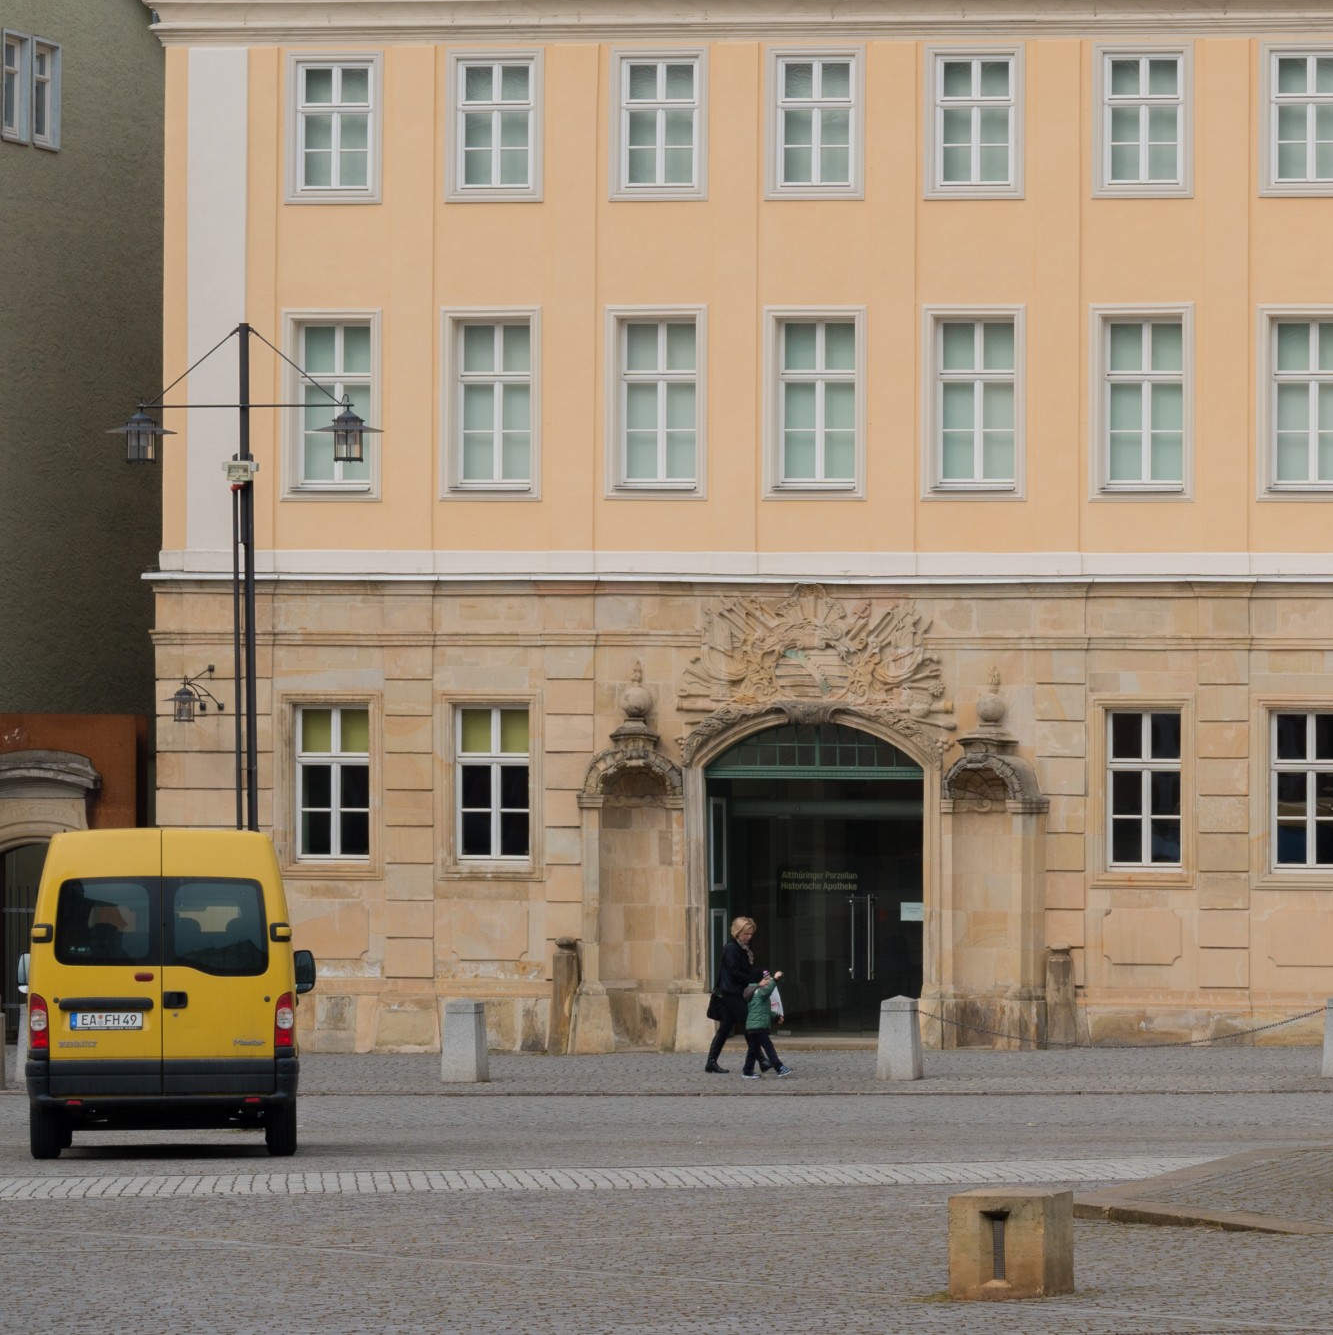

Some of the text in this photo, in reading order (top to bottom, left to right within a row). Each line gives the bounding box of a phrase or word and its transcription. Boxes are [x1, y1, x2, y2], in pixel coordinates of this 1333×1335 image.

[781, 871, 858, 880] Altthüringer Porzellan
[780, 881, 858, 892] Historische Apotheke
[81, 1014, 137, 1025] EA FH 49
